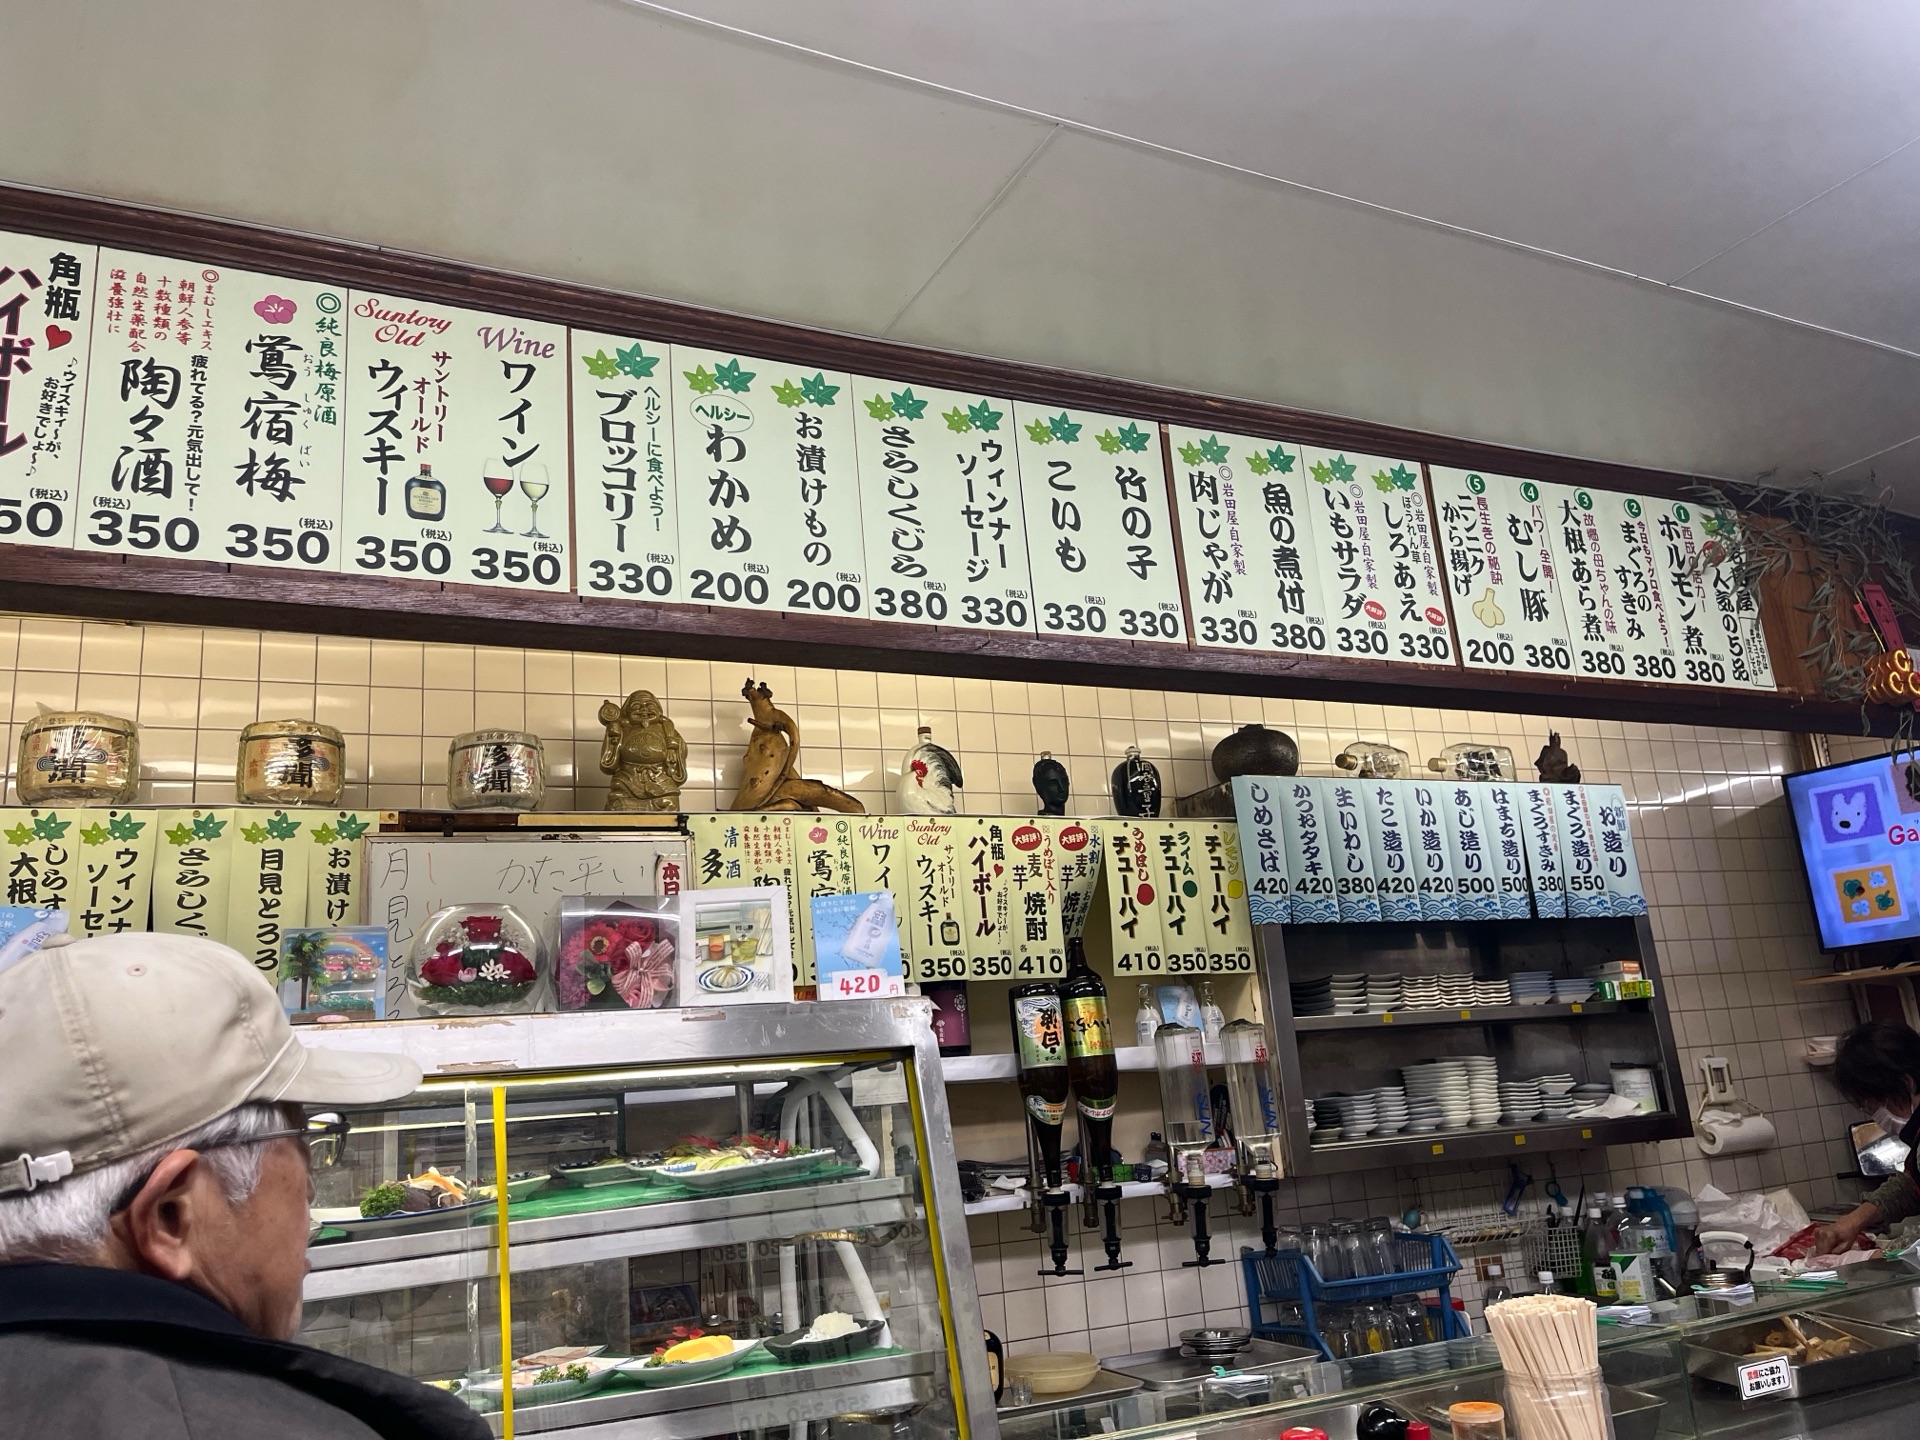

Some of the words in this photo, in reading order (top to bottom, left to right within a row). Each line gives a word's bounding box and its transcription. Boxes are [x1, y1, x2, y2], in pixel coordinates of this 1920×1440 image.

[43, 252, 80, 322] 角瓶
[105, 267, 125, 334] 滋養強壮に
[153, 276, 172, 341] 十数種類の
[128, 271, 147, 353] 自然生薬配合
[177, 279, 195, 347] 朝鮮人参等
[201, 284, 218, 353] まむしエキス
[354, 298, 453, 335] Suntory
[374, 323, 427, 348] Old
[477, 326, 556, 360] Wine
[313, 316, 339, 428] 純良梅原酒
[234, 333, 304, 503] 鶯宿梅
[410, 377, 432, 454] オールド
[431, 351, 453, 443] サントリー
[498, 360, 541, 468] ワイン
[694, 404, 751, 421] ヘルシー
[110, 356, 180, 500] 陶々酒
[595, 389, 638, 553] ブロッコリー
[705, 423, 753, 555] わかめ
[794, 411, 832, 567] お漬けもの
[881, 426, 928, 579] さらしくじら
[956, 452, 990, 583] ソーセージ
[1047, 460, 1087, 574] こいも
[1114, 464, 1159, 581] 竹の子
[87, 510, 198, 553] 350
[224, 523, 329, 567] 350
[1187, 470, 1234, 606] 肉じゃが
[1222, 482, 1248, 577] 岩田屋自家製
[1261, 481, 1306, 616] 魚の煮付
[1353, 500, 1379, 591] 岩田屋自家製
[1401, 495, 1423, 566] ほうれん草
[1414, 508, 1440, 597] 岩田屋自家製
[1441, 500, 1473, 598] から揚げ
[1457, 494, 1486, 577] ニンニク
[355, 536, 452, 576] 350
[470, 547, 561, 587] 350
[1322, 486, 1368, 621] いもサラダ
[1382, 501, 1424, 623] しろあえ
[1507, 513, 1551, 625] むし豚
[1557, 499, 1606, 643] 大根あら煮
[1621, 521, 1652, 612] まぐろの
[588, 562, 673, 596] 330
[690, 569, 770, 605] 200
[787, 579, 861, 613] 200
[1657, 514, 1708, 656] ホルモン煮
[874, 587, 948, 621] 380
[961, 595, 1028, 628] 330
[1042, 602, 1107, 633] 330
[1118, 608, 1179, 639] 330
[1613, 565, 1646, 641] すきみ
[1712, 567, 1751, 682] 人気の5品
[1200, 615, 1258, 646] 330
[1270, 622, 1326, 651] 380
[1335, 627, 1388, 656] 330
[1399, 632, 1450, 660] 330
[1466, 639, 1515, 666] 200
[1524, 644, 1571, 670] 380
[1581, 650, 1626, 676] 380
[1633, 655, 1677, 679] 380
[1684, 660, 1726, 683] 380
[858, 823, 900, 844] Wine
[906, 820, 952, 837] Suntory
[917, 833, 940, 846] Old
[989, 824, 1005, 861] 角瓶
[1014, 832, 1041, 847] 大好評！
[1062, 832, 1088, 846] 大好評！
[1250, 783, 1280, 873] しめさば
[1292, 784, 1323, 876] かつおタタキ
[1334, 786, 1364, 873] 生いわし
[1376, 786, 1405, 873] たこ造り
[1415, 787, 1443, 873] いか造り
[1455, 787, 1483, 873] あじ造り
[1491, 788, 1521, 875] はまち造り
[1527, 789, 1556, 873] まぐろすきみ
[1563, 789, 1592, 874] まぐろ造り
[1599, 806, 1627, 878] お造り
[724, 826, 741, 879] 清酒
[944, 844, 956, 899] サントリー
[1027, 853, 1043, 879] 麦
[1075, 853, 1088, 878] 麦
[1089, 834, 1101, 880] 水割り
[1177, 830, 1194, 876] ライム
[1222, 831, 1239, 874] レモン
[40, 844, 68, 910] しらす
[936, 862, 950, 908] オールド
[967, 836, 996, 938] ハイボール
[1012, 866, 1028, 890] 芋
[1061, 865, 1074, 890] 芋
[1112, 834, 1139, 939] チューハイ
[1159, 834, 1187, 936] チューハイ
[1204, 834, 1230, 935] チューハイ
[1253, 877, 1289, 894] 420
[1295, 877, 1333, 894] 420
[1338, 877, 1375, 894] 380
[1377, 877, 1416, 894] 420
[1419, 877, 1454, 893] 420
[1458, 877, 1495, 893] 500
[1501, 877, 1528, 893] 500
[1537, 876, 1564, 891] 380
[1570, 875, 1605, 891] 550
[254, 848, 284, 972] 月見とろろ
[1024, 891, 1048, 942] 焼酎
[839, 974, 880, 996] 420
[889, 983, 899, 995] 円
[921, 957, 967, 979] 350
[972, 956, 1012, 977] 350
[1018, 955, 1063, 975] 410
[1117, 952, 1161, 973] 410
[1168, 953, 1208, 973] 350
[1210, 953, 1252, 973] 350
[1749, 1375, 1786, 1392] お願いします！
